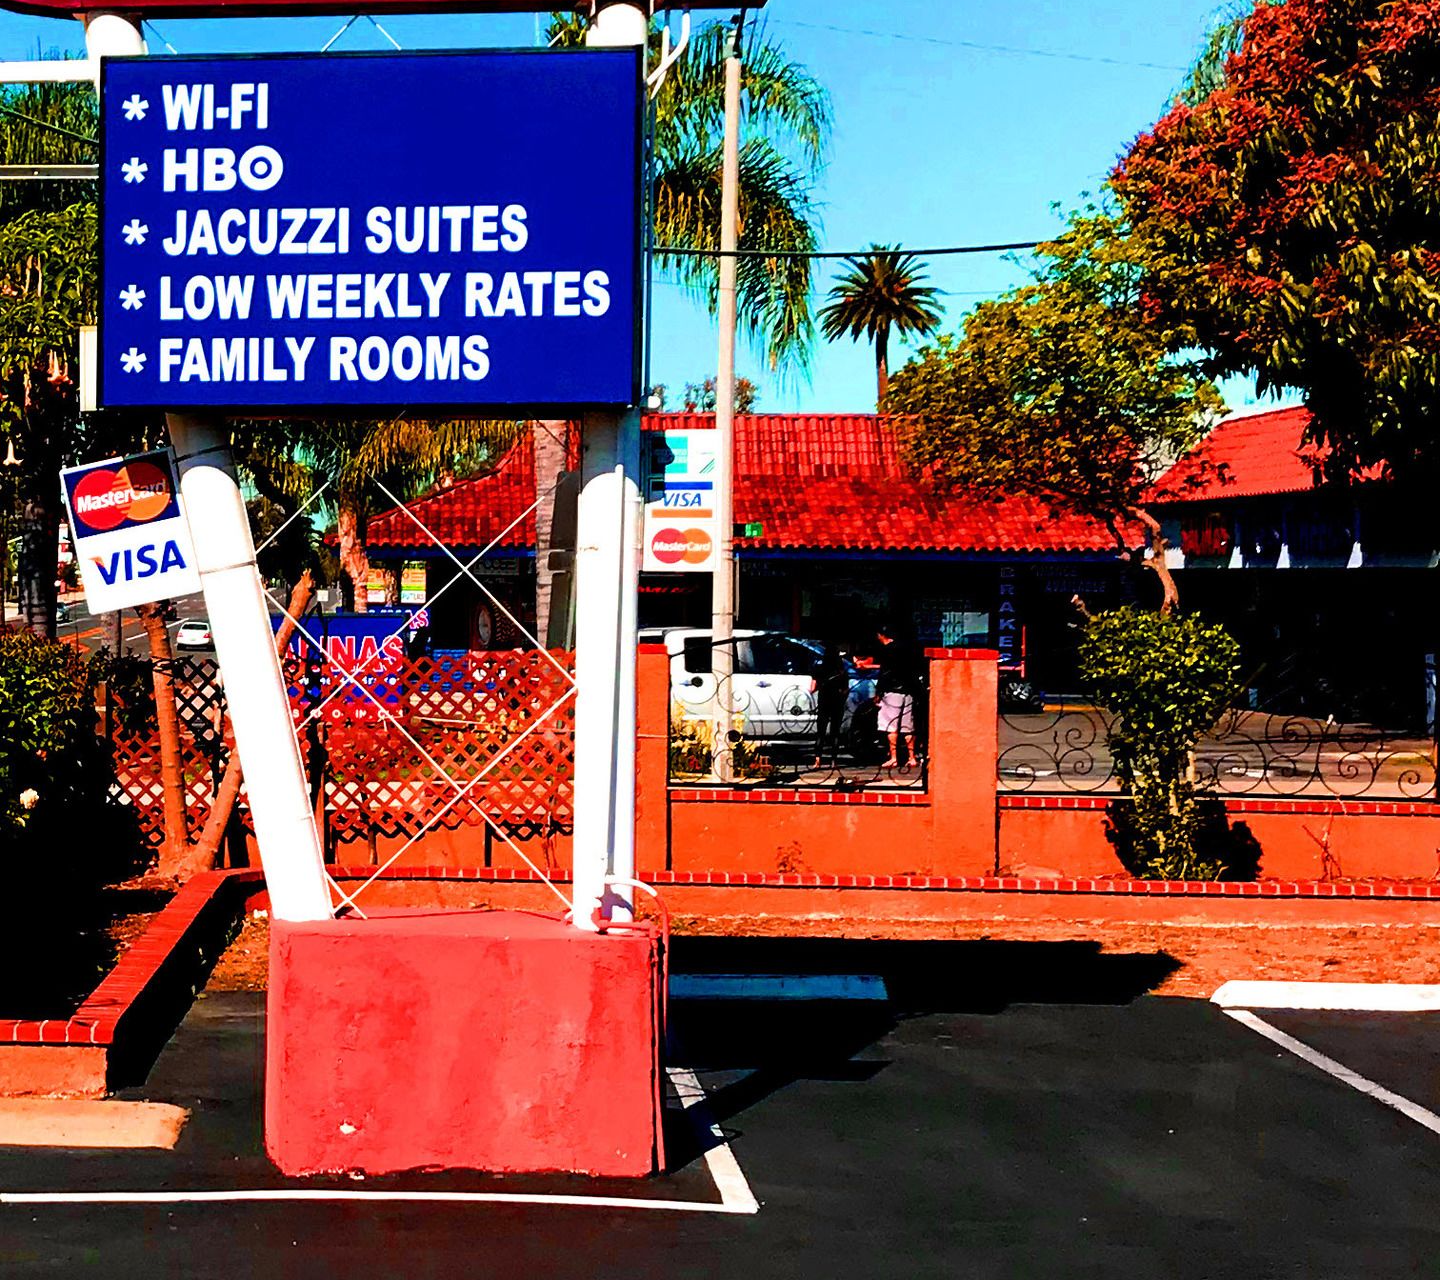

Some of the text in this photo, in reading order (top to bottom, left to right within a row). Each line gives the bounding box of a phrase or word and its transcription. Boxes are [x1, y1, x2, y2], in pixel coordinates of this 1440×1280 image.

[161, 82, 270, 131] WI-FI
[162, 145, 285, 193] HBO
[162, 204, 529, 257] JACUZZI SUITES
[159, 269, 611, 322] LOW WEEKLY RATES
[159, 334, 491, 383] FAMILY ROOMS
[76, 478, 167, 514] MasterCard
[662, 492, 703, 507] VISA
[88, 539, 187, 585] VISA
[652, 540, 712, 553] MasterCard
